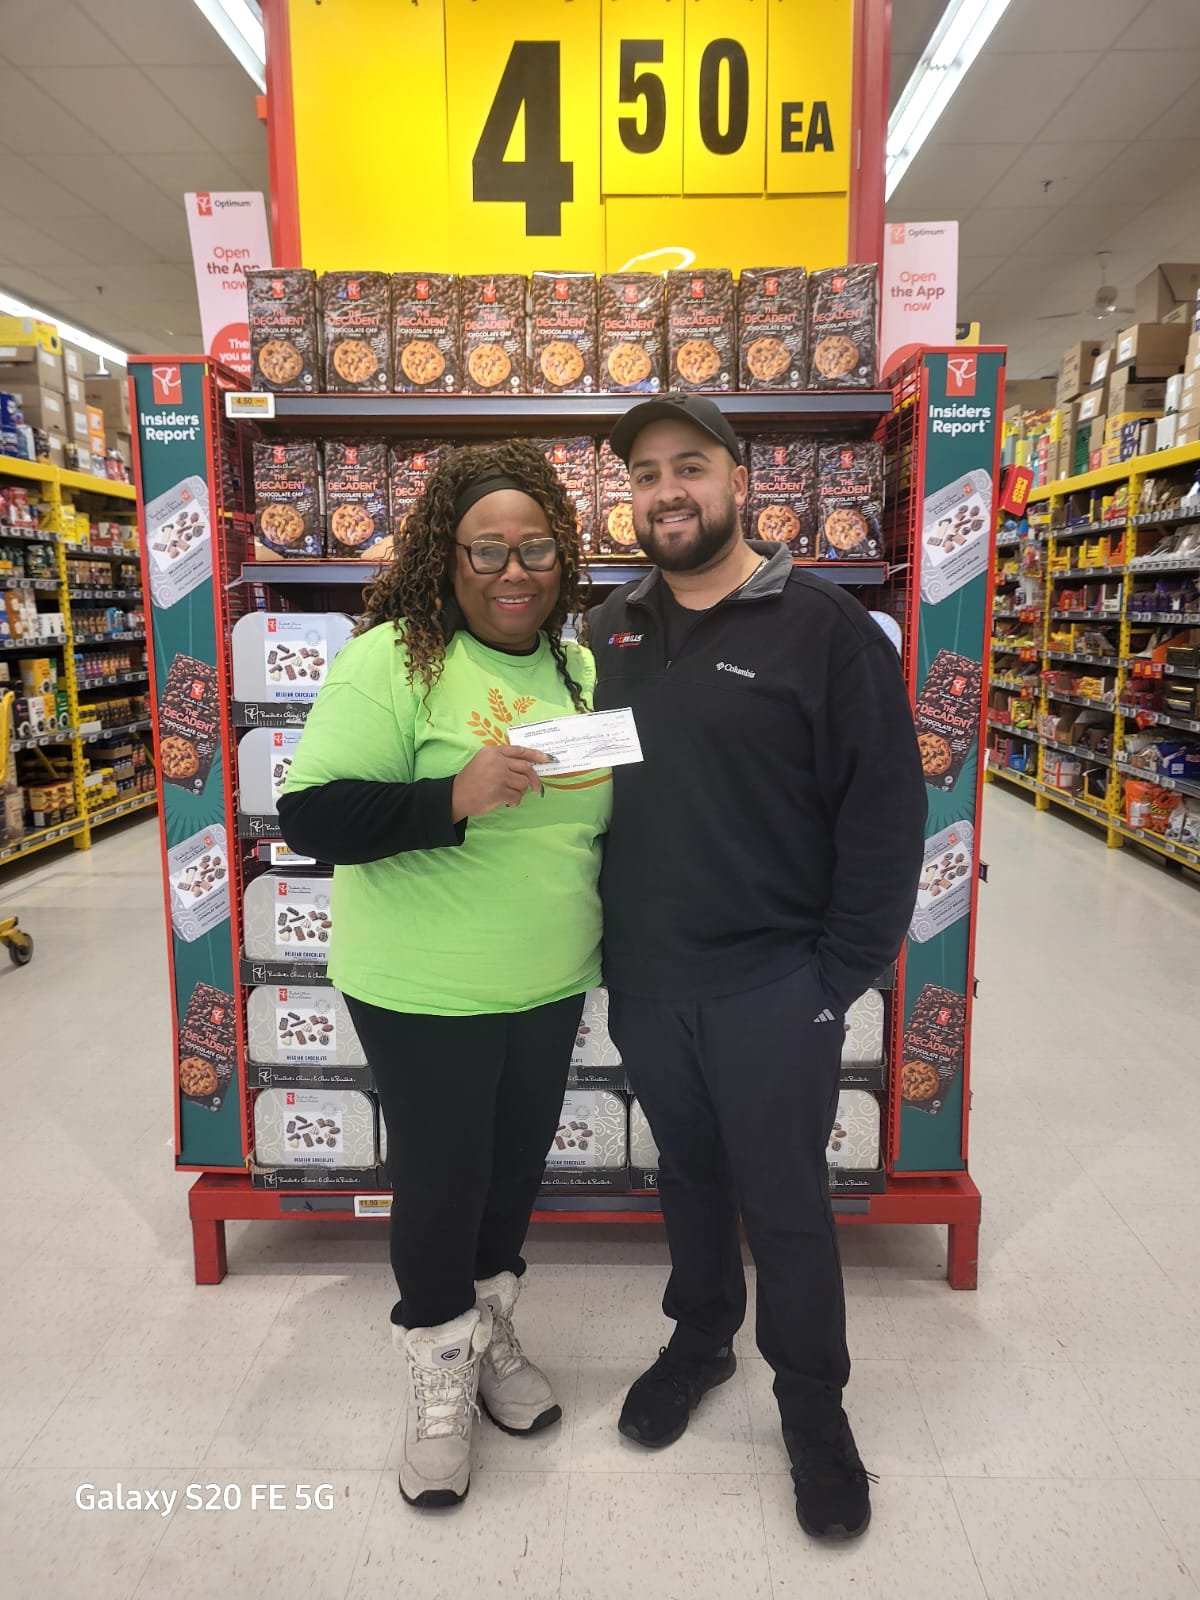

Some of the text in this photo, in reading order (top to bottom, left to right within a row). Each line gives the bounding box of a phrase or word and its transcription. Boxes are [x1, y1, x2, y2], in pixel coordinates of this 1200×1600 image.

[473, 40, 573, 236] 4
[781, 101, 833, 153] EA
[214, 200, 251, 209] Optimum
[908, 229, 945, 237] Optimum
[213, 246, 250, 261] Open
[207, 262, 229, 274] the
[900, 271, 936, 285] Open
[891, 285, 945, 299] the App
[904, 302, 932, 312] now
[397, 317, 448, 327] DECADENT
[536, 317, 588, 327] DECADENT
[605, 319, 657, 329] DECADENT
[672, 315, 725, 326] DECADENT
[744, 313, 798, 324] DECADENT
[465, 319, 515, 331] DECADENT
[219, 353, 240, 363] you
[929, 404, 991, 418] Insiders
[140, 412, 199, 426] Insiders
[255, 480, 306, 490] DECADENT
[328, 481, 379, 491] DECADENT
[604, 480, 631, 490] DECA
[754, 481, 805, 491] DECADENT
[821, 485, 872, 496] DECADENT
[724, 663, 755, 679] Columbia
[185, 707, 199, 718] THE
[942, 703, 958, 714] THE
[163, 708, 216, 734] DECADENT
[919, 704, 973, 730] DECADENT
[920, 716, 952, 733] CHOCOLATE
[185, 1030, 234, 1056] DECADENT
[930, 1033, 943, 1042] THE
[908, 1034, 959, 1057] DECADENT
